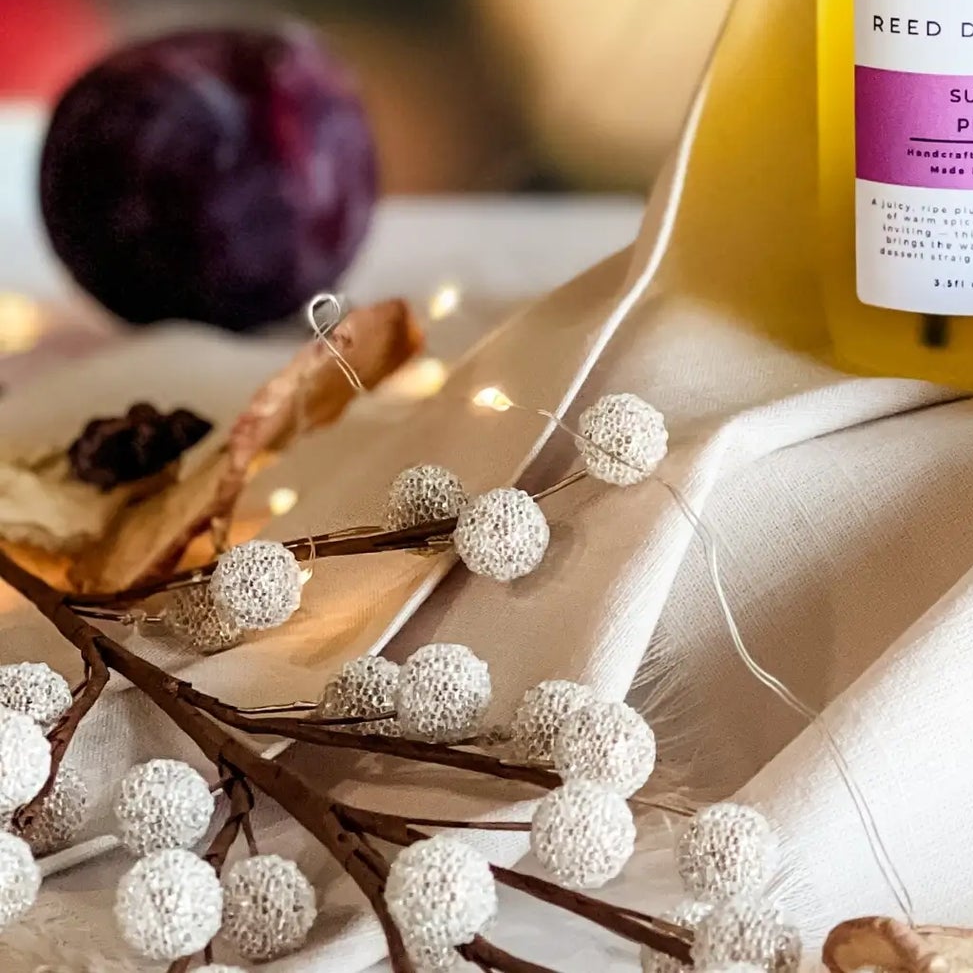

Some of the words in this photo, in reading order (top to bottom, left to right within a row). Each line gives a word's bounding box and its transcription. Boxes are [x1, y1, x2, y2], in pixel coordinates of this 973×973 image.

[873, 15, 942, 37] REED
[930, 166, 964, 175] Made
[887, 212, 897, 220] of
[922, 206, 947, 214] ripe
[883, 224, 931, 238] inviting
[886, 236, 925, 248] brings
[931, 241, 952, 249] the
[880, 247, 924, 259] dessert
